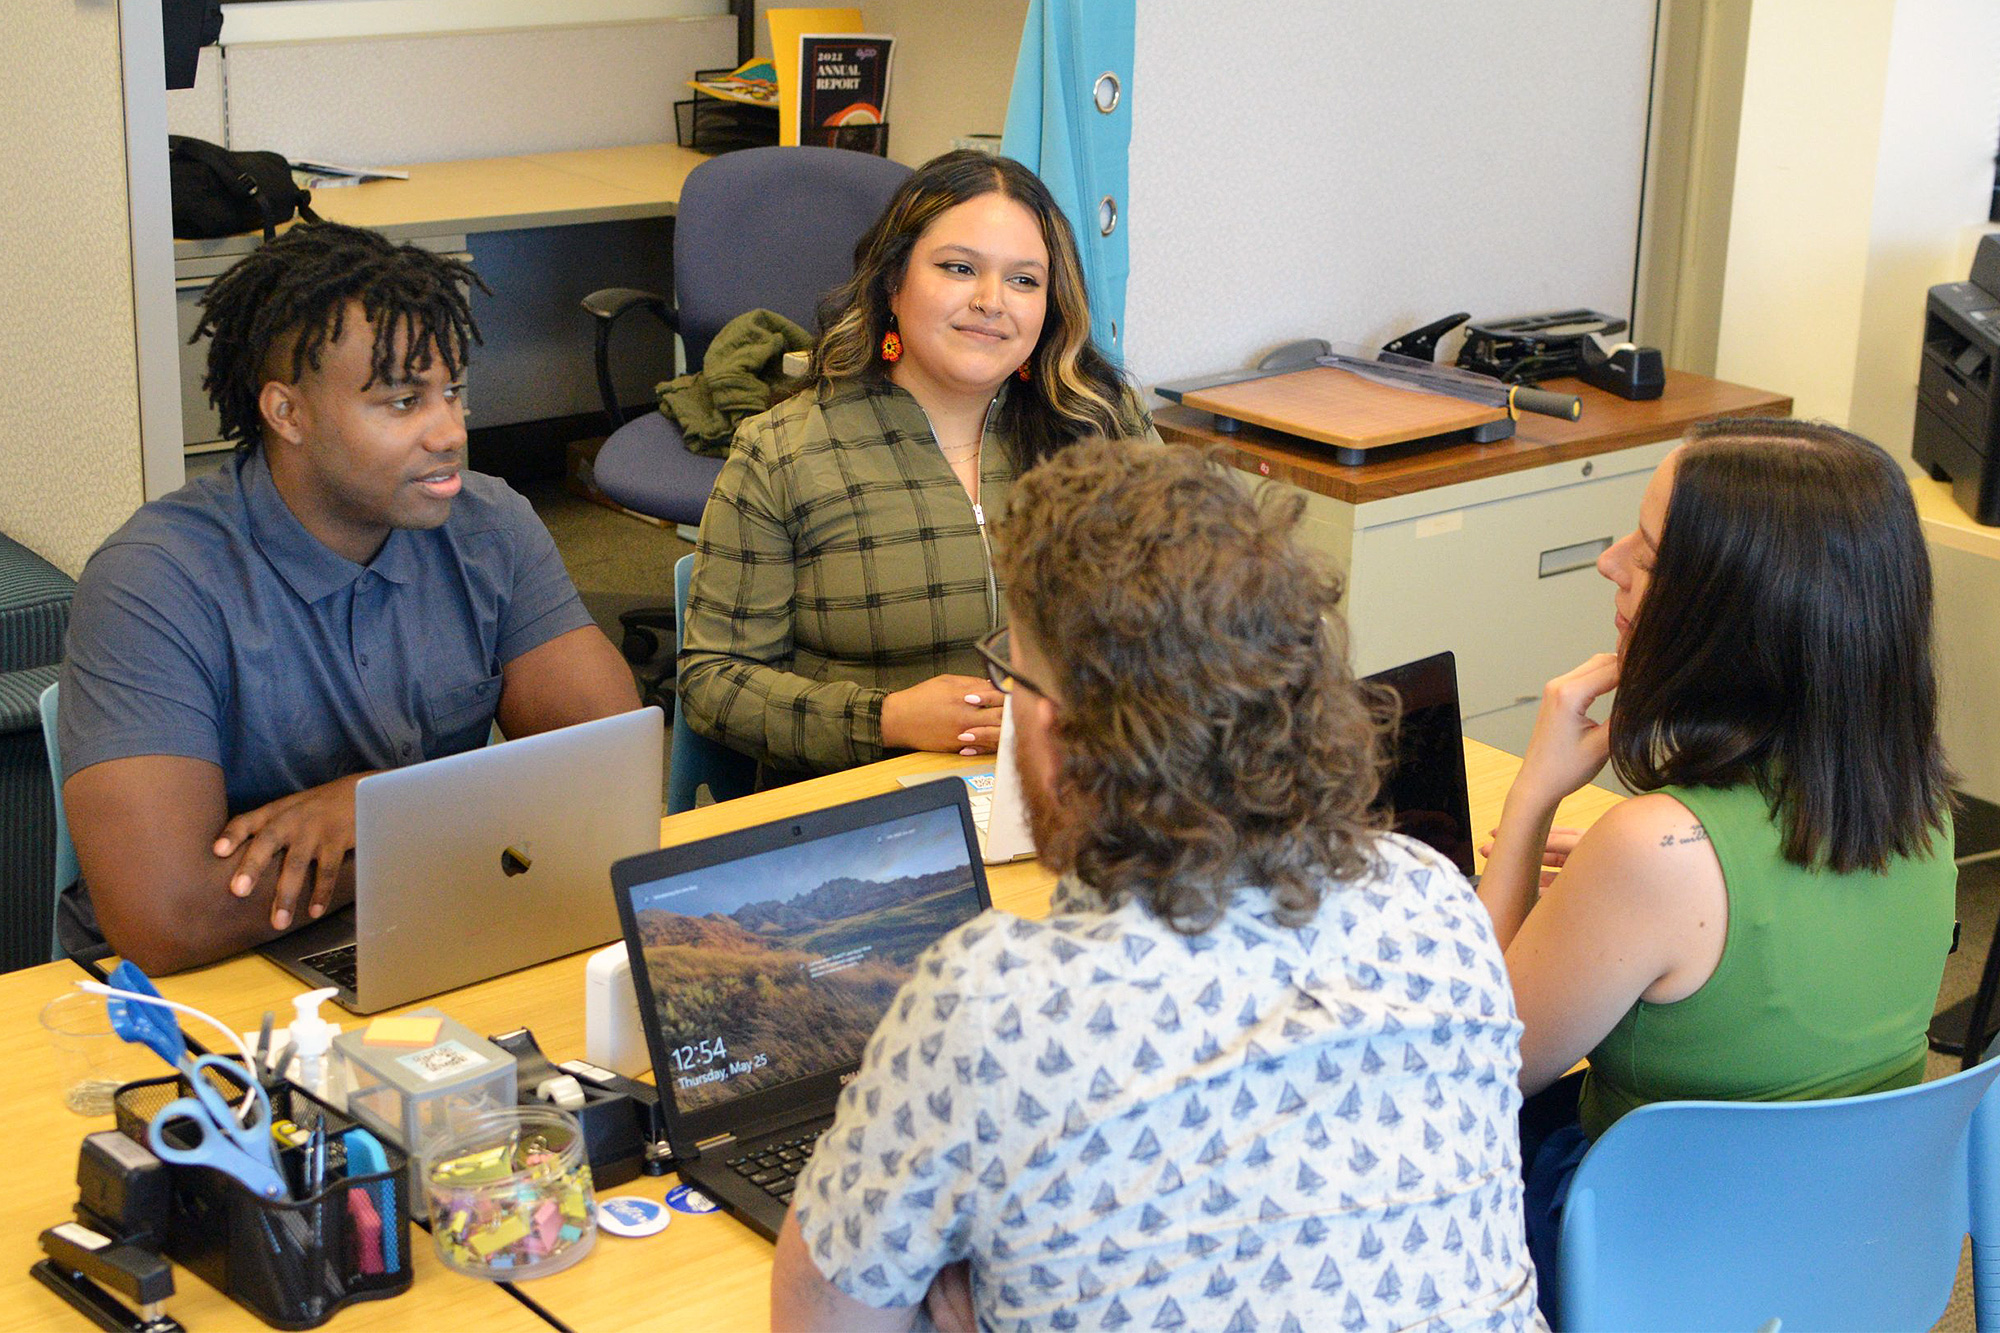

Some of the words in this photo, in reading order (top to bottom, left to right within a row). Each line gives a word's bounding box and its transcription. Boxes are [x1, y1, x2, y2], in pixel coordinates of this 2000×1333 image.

[817, 64, 861, 76] ANNUAL
[816, 78, 861, 90] REPORT
[671, 1036, 727, 1072] 12:54
[677, 1068, 729, 1090] Thursday,
[729, 1059, 753, 1075] May
[753, 1053, 768, 1069] 25
